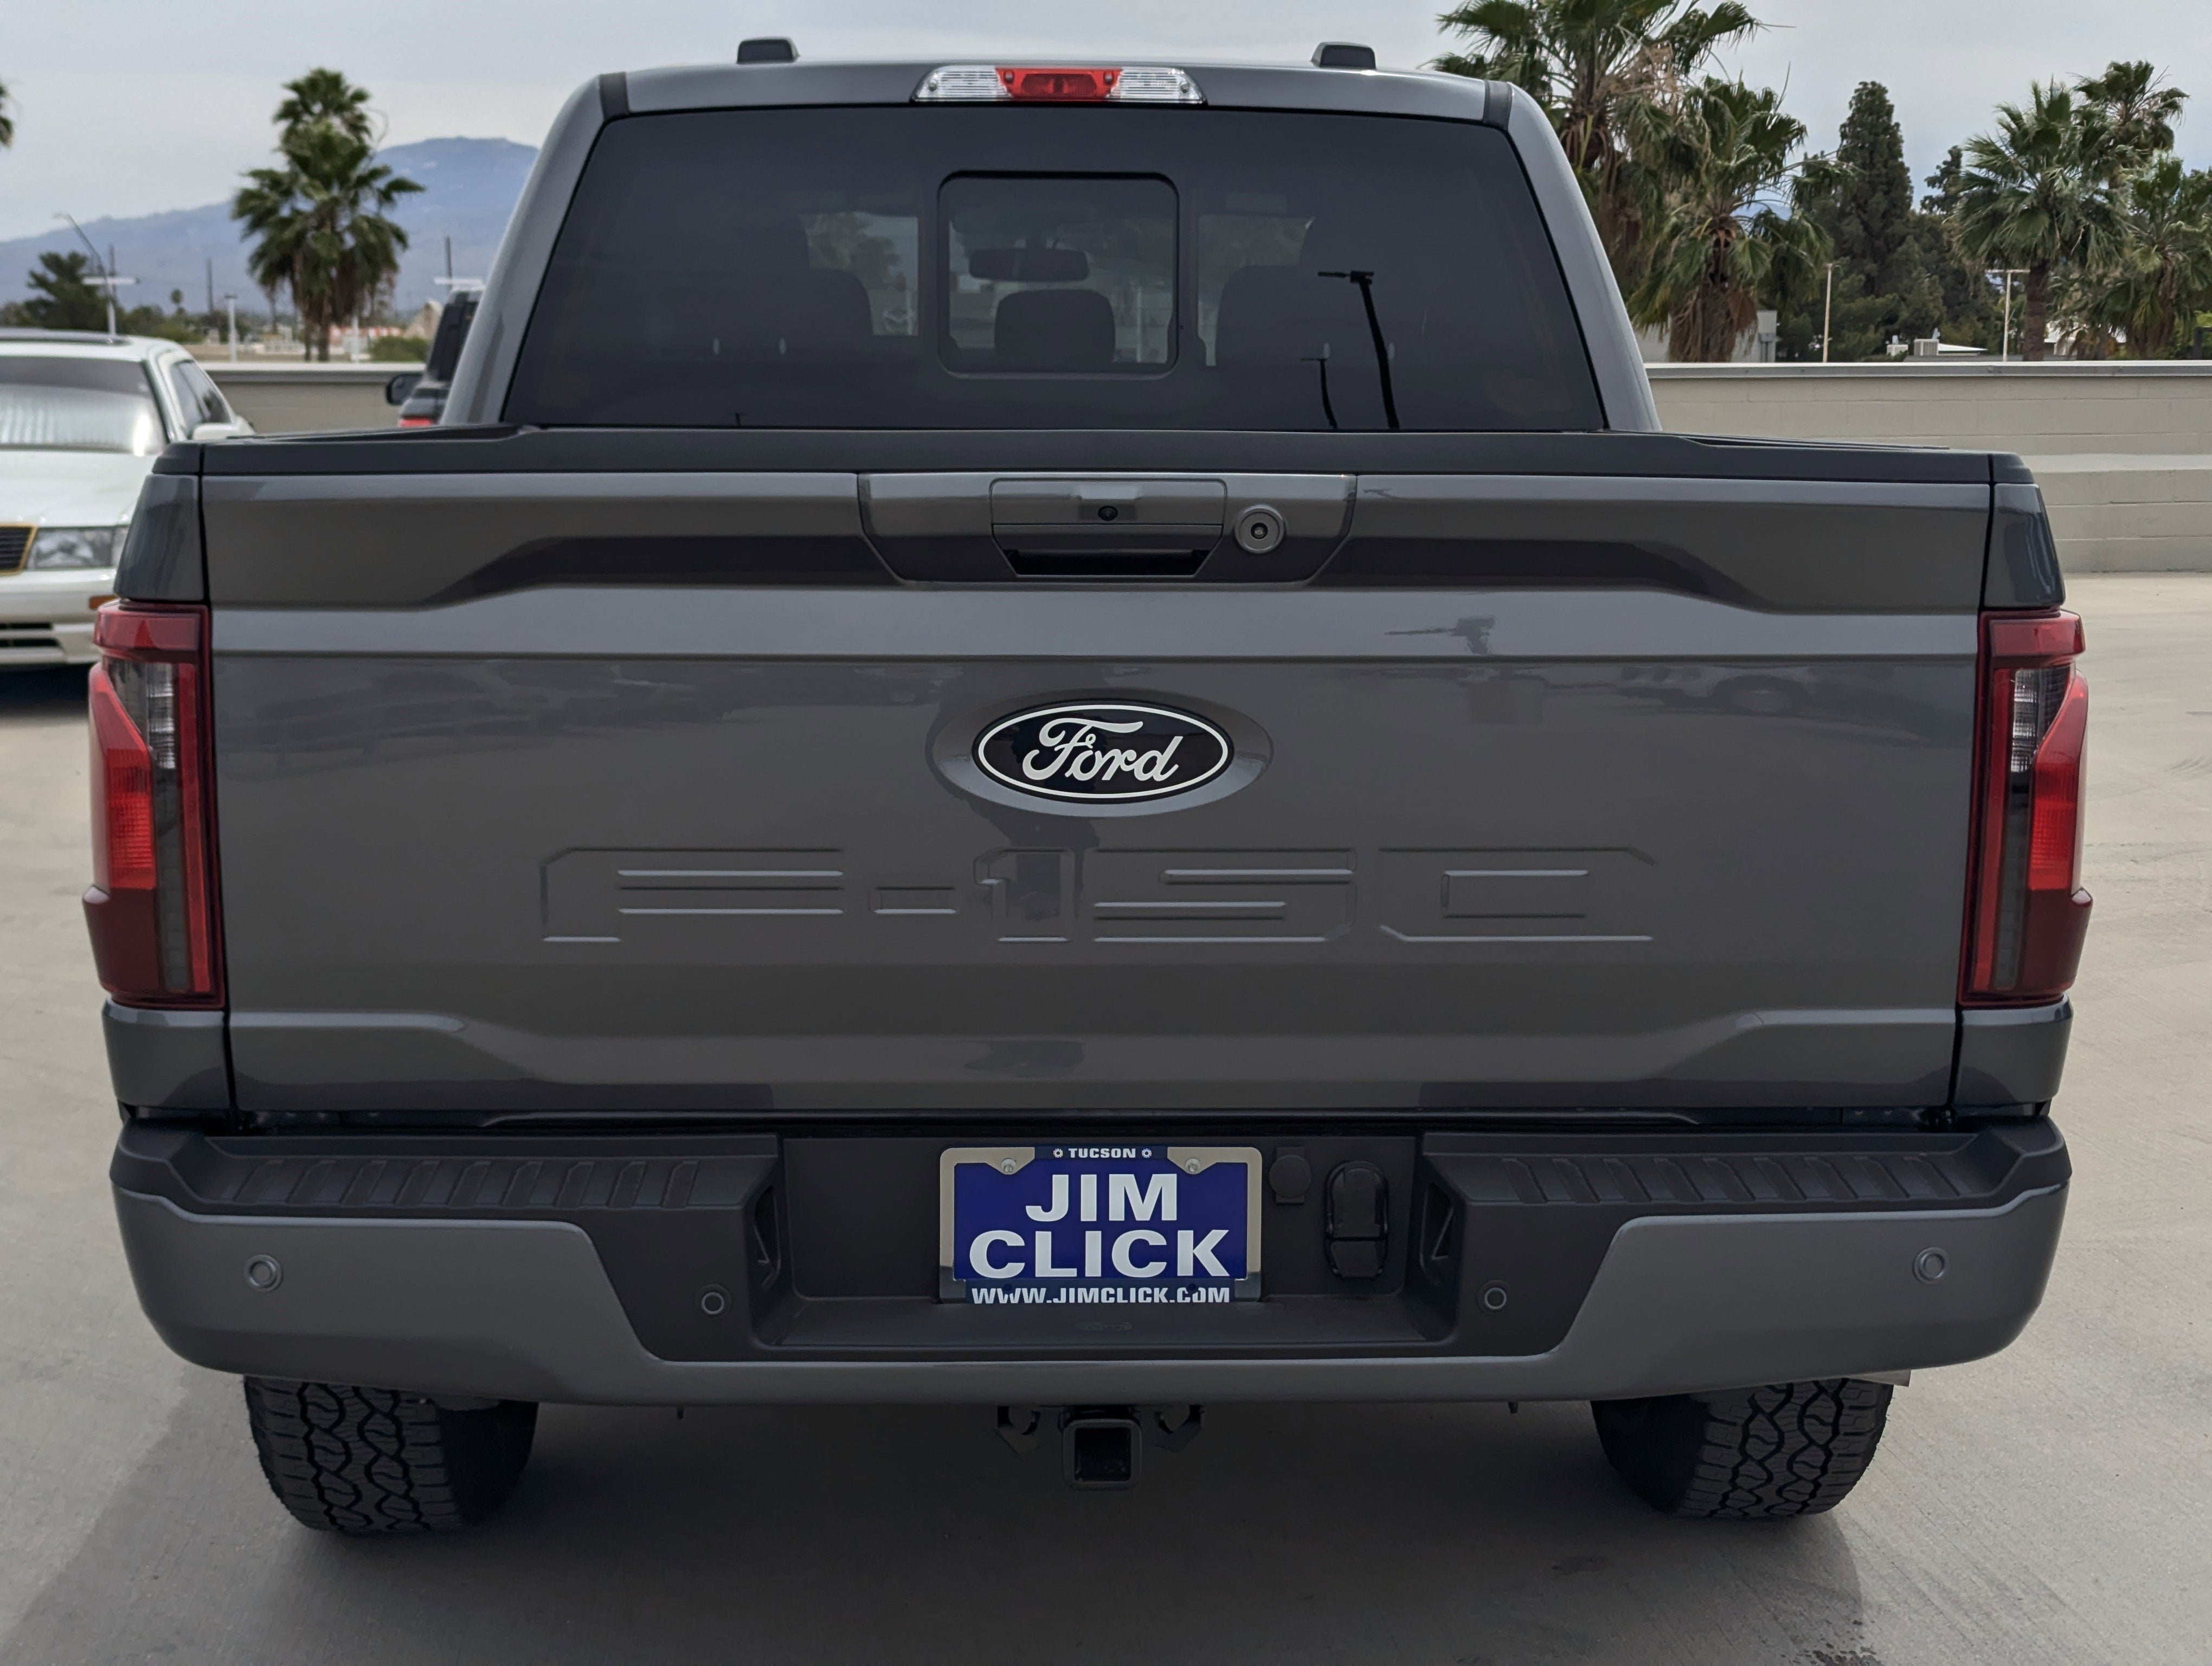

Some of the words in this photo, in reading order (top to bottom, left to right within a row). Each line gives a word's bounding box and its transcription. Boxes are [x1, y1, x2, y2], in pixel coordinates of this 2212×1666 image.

[1022, 717, 1184, 781] Ford
[541, 847, 1656, 945] F-150
[1068, 1148, 1136, 1158] TUCSON
[1025, 1173, 1178, 1222] JIM
[969, 1229, 1230, 1279] CLICK
[971, 1287, 1230, 1304] WWW.JIMCLICK.COM
